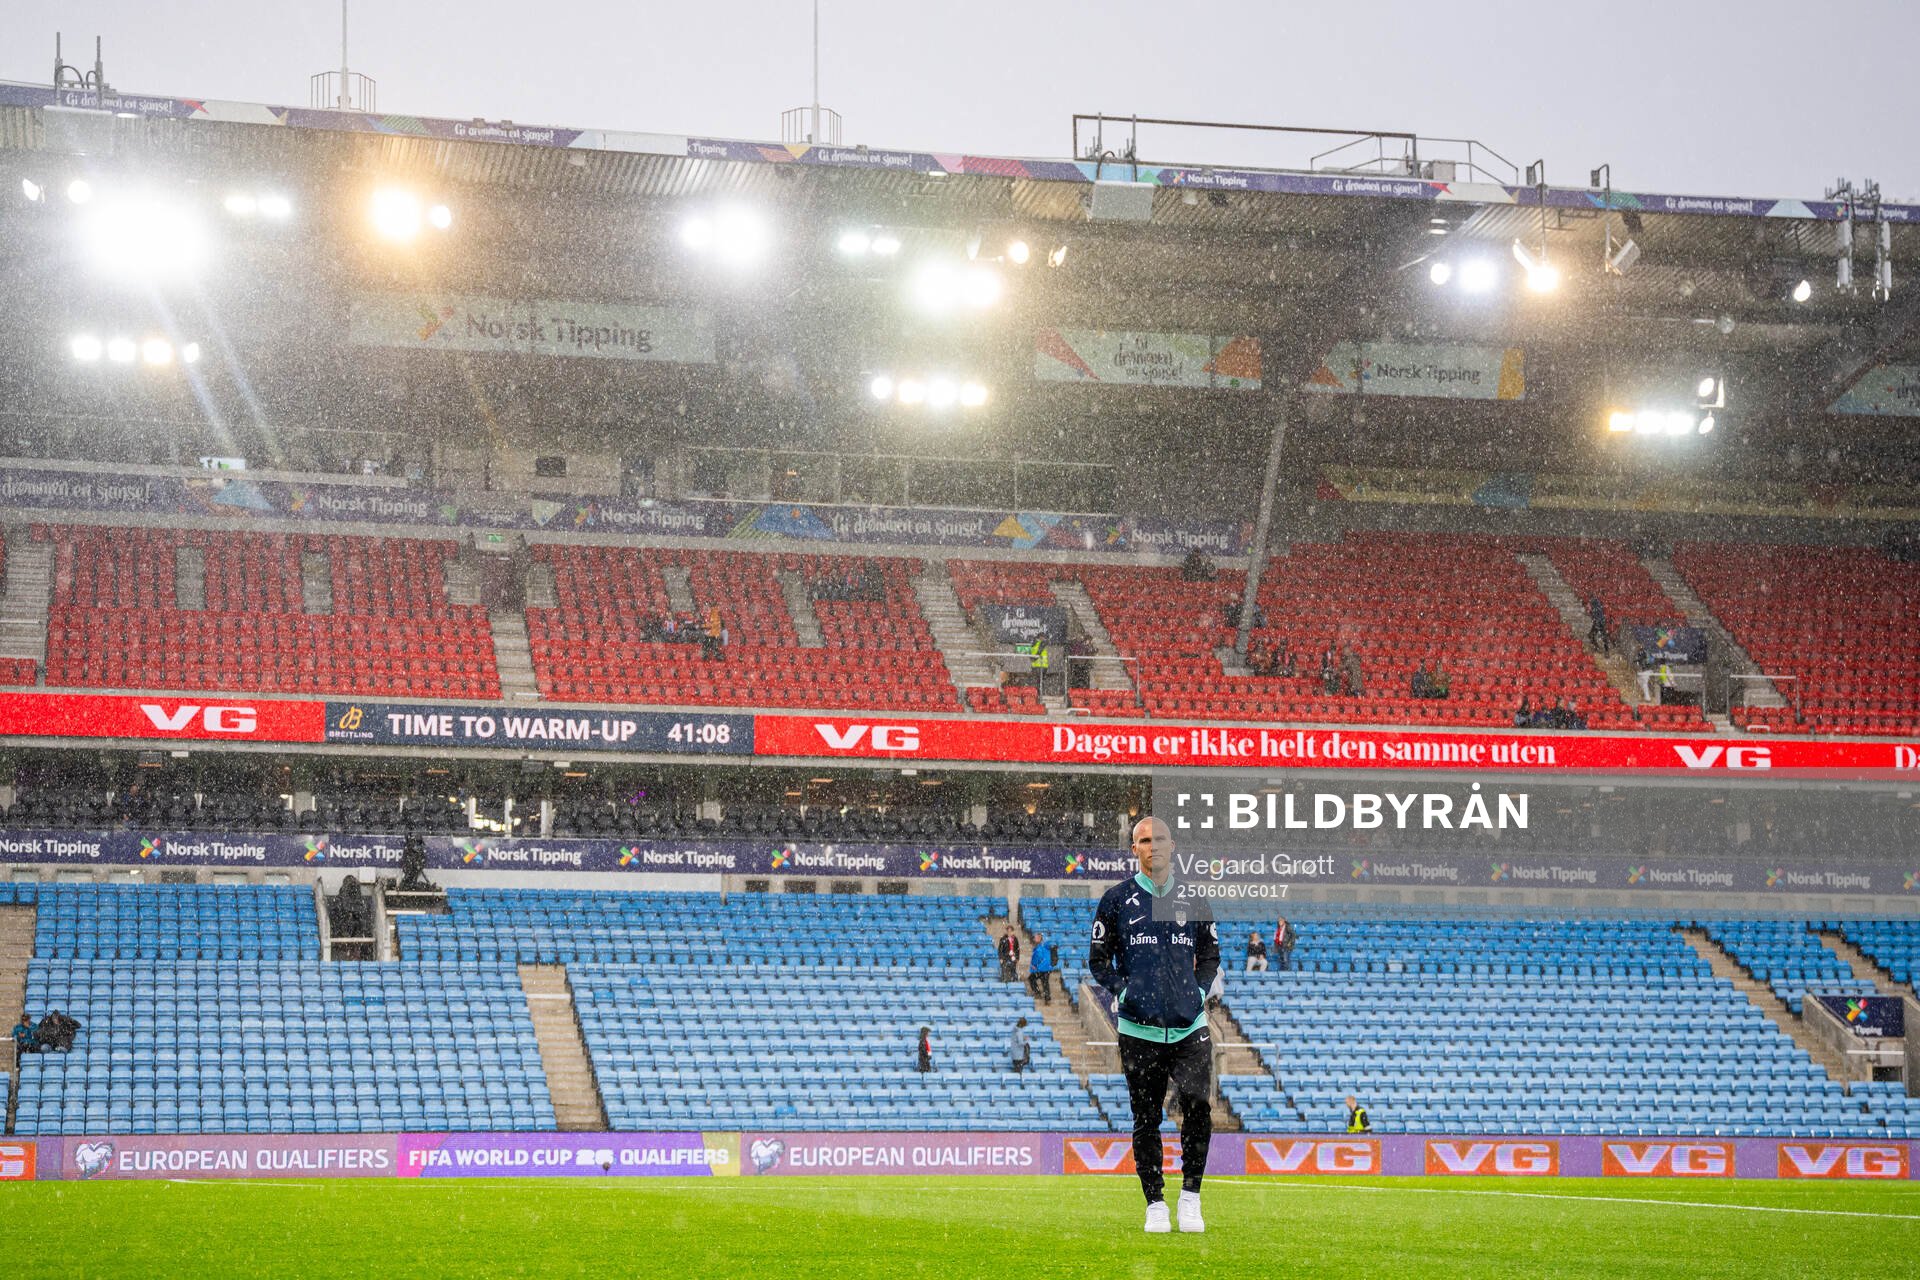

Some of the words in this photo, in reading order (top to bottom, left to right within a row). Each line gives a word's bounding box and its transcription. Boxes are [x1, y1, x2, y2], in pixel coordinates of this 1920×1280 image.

[1187, 173, 1214, 184] Norsk
[1215, 175, 1248, 188] Tipping
[466, 312, 545, 342] Norsk
[551, 317, 652, 353] Tipping
[1376, 362, 1422, 381] Norsk
[1426, 364, 1481, 385] Tipping
[318, 496, 368, 513] Norsk
[369, 498, 428, 519] Tipping
[600, 510, 647, 527] Norsk
[650, 512, 706, 532] Tipping
[1131, 526, 1176, 545] Norsk
[1176, 530, 1230, 550] Tipping
[140, 704, 257, 732] VG
[388, 713, 453, 736] TIME
[459, 716, 496, 738] TO
[503, 717, 637, 742] WARM-UP
[667, 723, 730, 744] 41:08
[814, 724, 920, 750] VG
[1053, 727, 1147, 760] Dagen
[1153, 736, 1185, 755] er
[1191, 730, 1254, 757] ikke
[1261, 731, 1316, 758] helt
[1323, 733, 1376, 760] den
[1383, 741, 1486, 763] samme
[1491, 740, 1556, 764] uten
[1673, 745, 1771, 770] VG
[0, 839, 41, 853] Norsk
[43, 840, 100, 857] Tipping
[166, 842, 208, 856] Norsk
[209, 843, 265, 860] Tipping
[329, 844, 371, 860] Norsk
[487, 847, 529, 862] Norsk
[530, 848, 582, 865] Tipping
[643, 850, 684, 864] Norsk
[684, 851, 736, 868] Tipping
[795, 853, 834, 867] Norsk
[836, 854, 885, 871] Tipping
[942, 856, 981, 870] Norsk
[982, 857, 1031, 873] Tipping
[1088, 858, 1126, 872] Norsk
[1373, 863, 1411, 877] Norsk
[1412, 863, 1459, 880] Tipping
[1512, 866, 1549, 880] Norsk
[1549, 867, 1598, 883] Tipping
[1650, 869, 1687, 883] Norsk
[1687, 869, 1734, 886] Tipping
[1787, 872, 1823, 886] Norsk
[1824, 872, 1871, 889] Tipping
[120, 1150, 248, 1171] EUROPEAN
[256, 1149, 389, 1170] QUALIFIERS
[409, 1150, 451, 1166] FIFA
[455, 1150, 526, 1166] WORLD
[532, 1150, 573, 1166] CUP
[620, 1149, 729, 1166] QUALIFIERS
[790, 1147, 905, 1166] EUROPEAN
[912, 1147, 1033, 1166] QUALIFIERS
[1251, 1142, 1372, 1171] VG
[1430, 1143, 1550, 1172] VG
[1607, 1144, 1727, 1174] VG
[1783, 1146, 1900, 1175] VG
